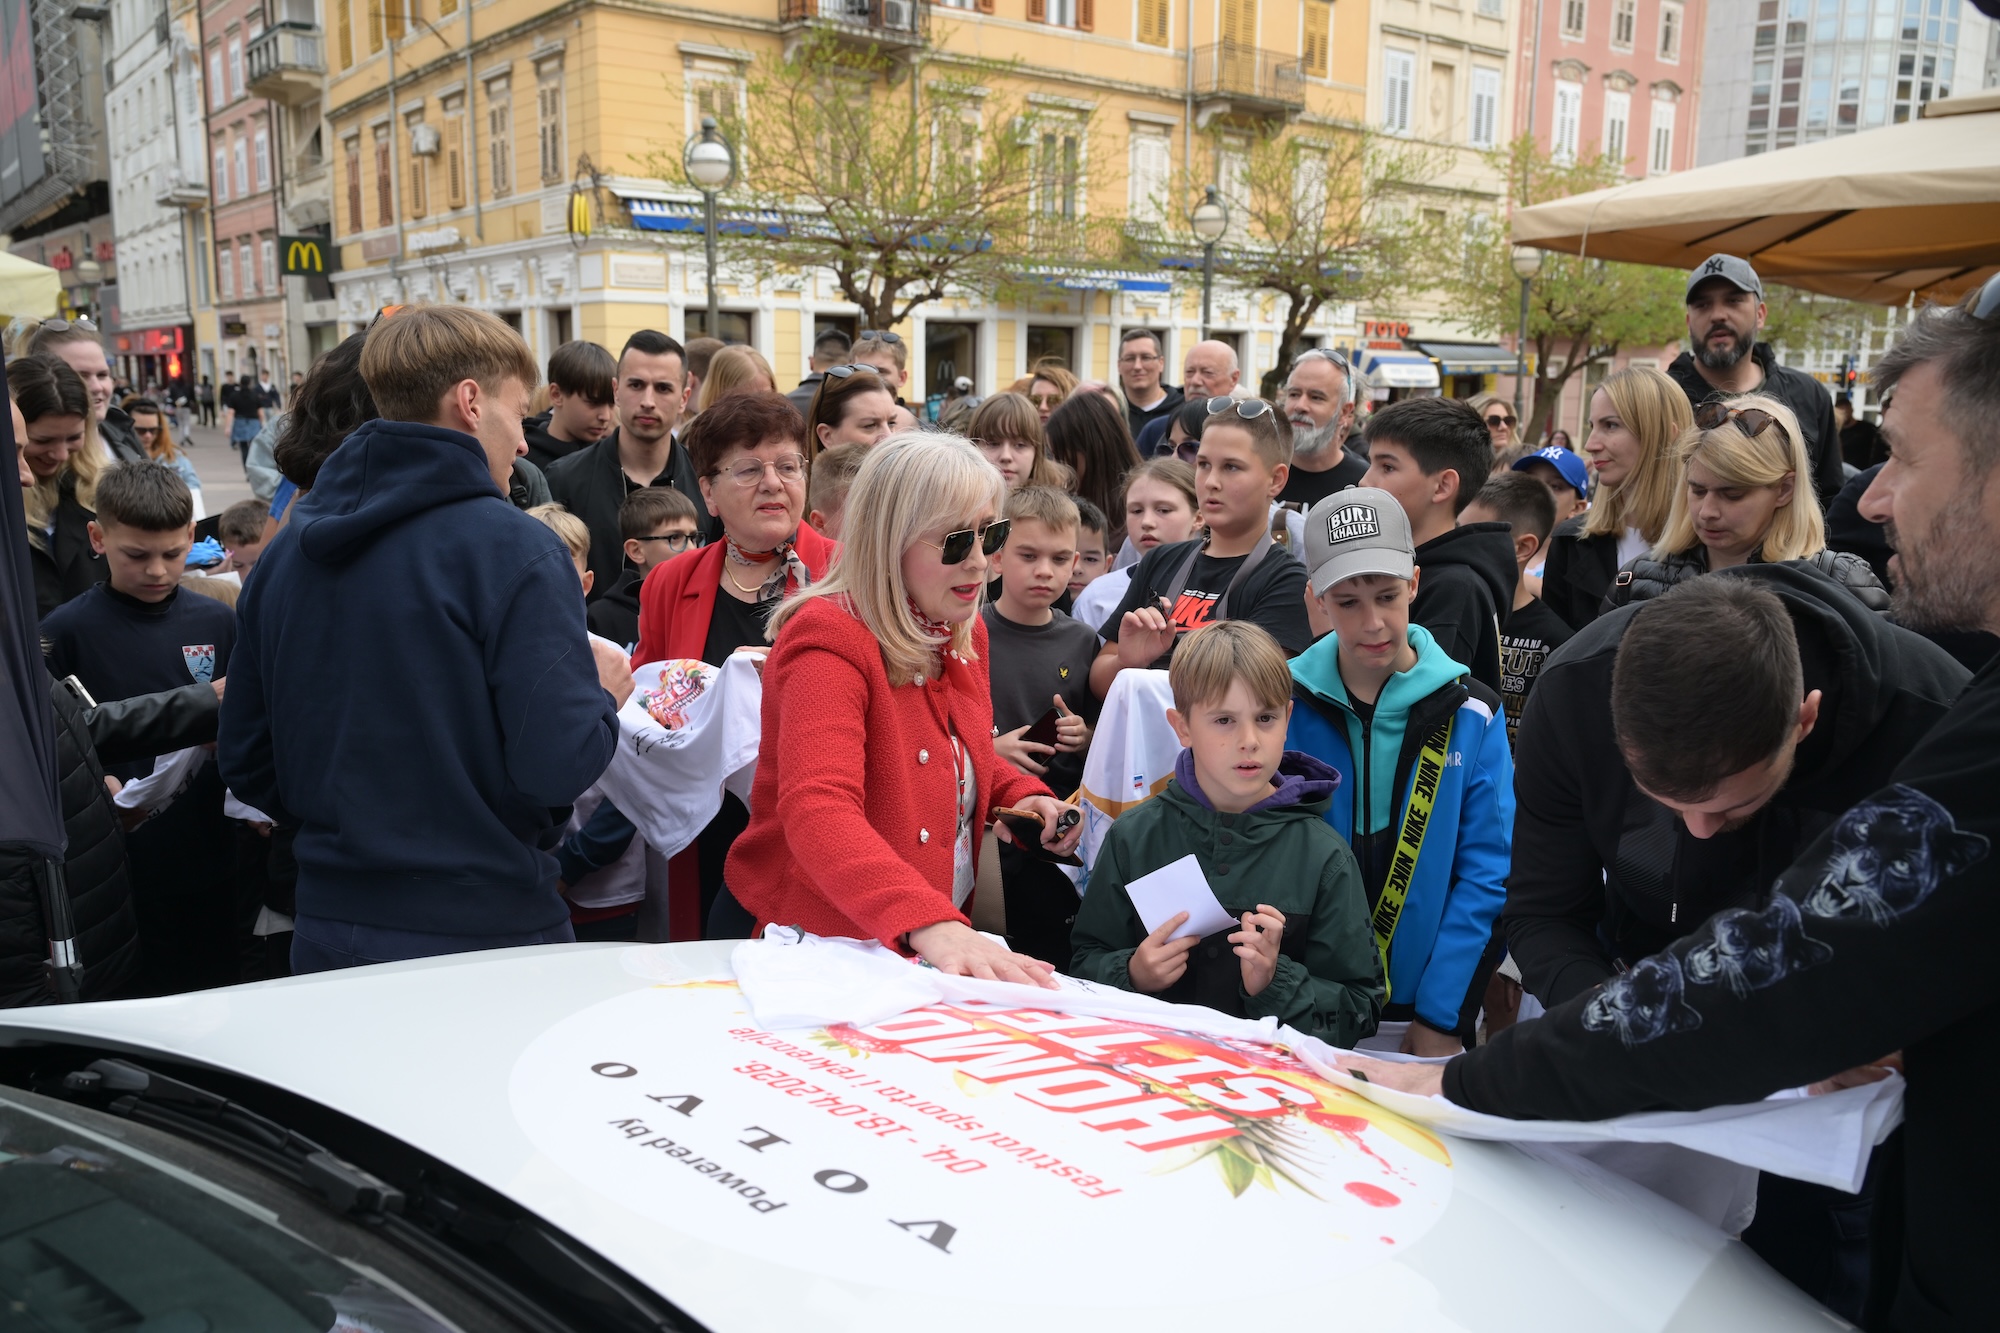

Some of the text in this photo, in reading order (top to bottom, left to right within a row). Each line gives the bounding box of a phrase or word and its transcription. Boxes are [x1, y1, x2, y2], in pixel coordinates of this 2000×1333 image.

[1704, 258, 1724, 274] NY
[1365, 321, 1410, 338] FOTO
[1540, 446, 1564, 460] NY
[1331, 507, 1373, 529] BURJ
[1332, 523, 1376, 540] KHALIFA
[1512, 638, 1542, 649] BRAND
[1500, 675, 1526, 693] ES
[1414, 755, 1441, 804] NIKE
[1402, 803, 1428, 850] NIKE
[1388, 850, 1415, 896] NIKE
[1373, 895, 1400, 940] NIKE
[733, 1060, 914, 1138] 18.04.2026.
[857, 1010, 1241, 1150] HOMO
[1124, 1055, 1320, 1115] SI
[728, 1027, 1123, 1199] Festival sporta i rekreacije
[590, 1061, 958, 1254] VOLVO
[608, 1117, 789, 1214] Powered by
[921, 1144, 988, 1174] 04.
